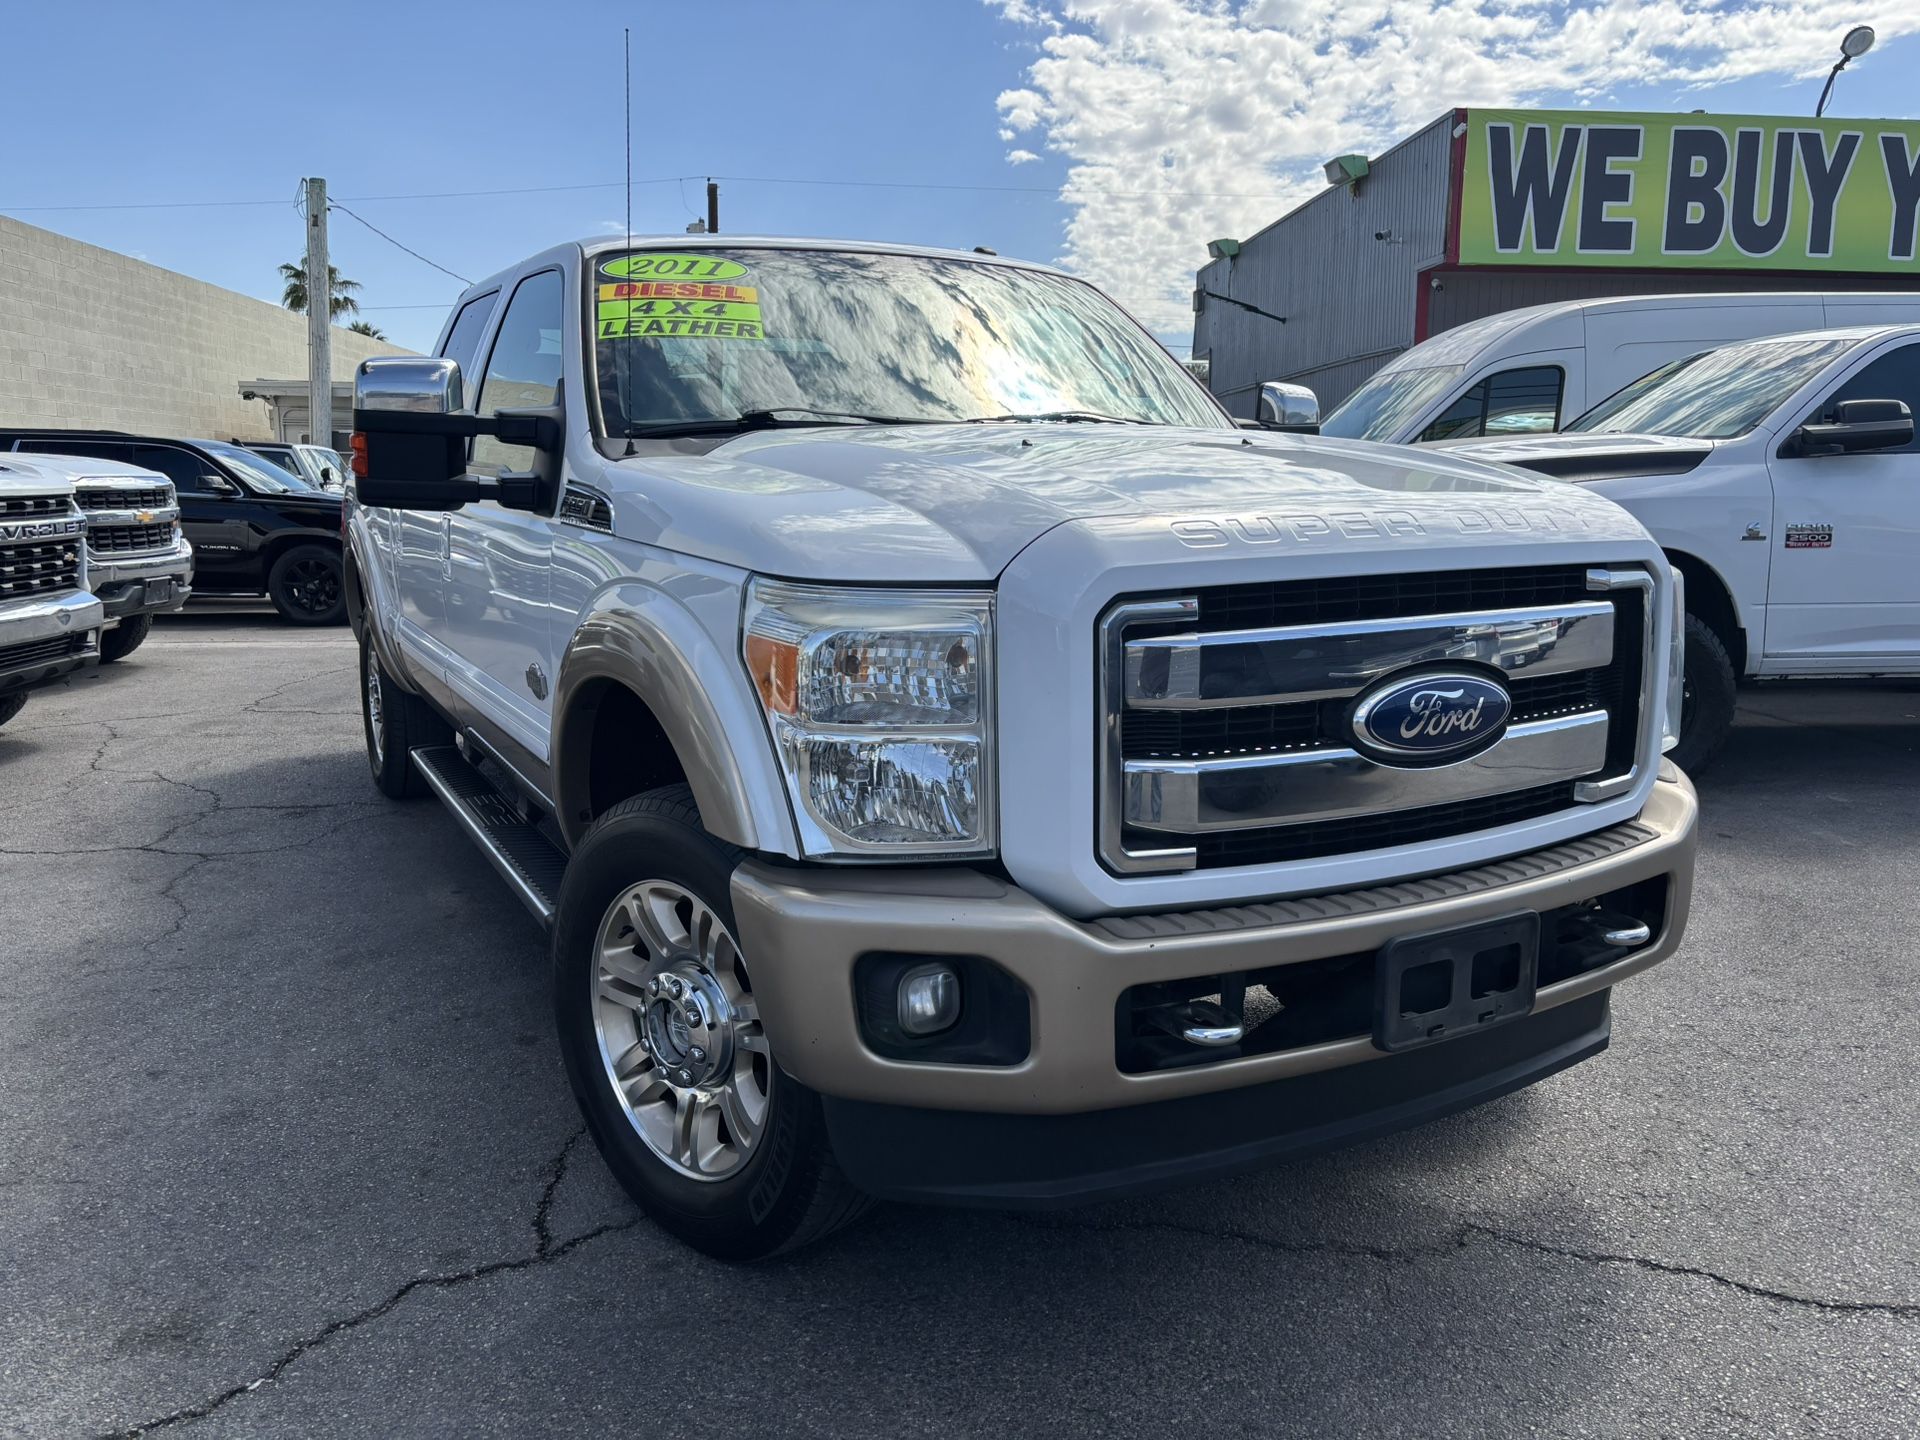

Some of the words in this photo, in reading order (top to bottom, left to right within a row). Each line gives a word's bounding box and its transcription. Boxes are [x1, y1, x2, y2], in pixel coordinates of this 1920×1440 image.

[1487, 124, 1644, 253] WE
[1662, 126, 1864, 257] BUY
[626, 259, 724, 276] 2011
[613, 283, 745, 299] DIESEL
[602, 319, 760, 337] LEATHER
[0, 521, 86, 540] VROLET
[1170, 510, 1426, 548] SUPER
[1444, 508, 1590, 534] DUTY
[1789, 534, 1829, 542] 2500
[1400, 688, 1485, 739] Ford
